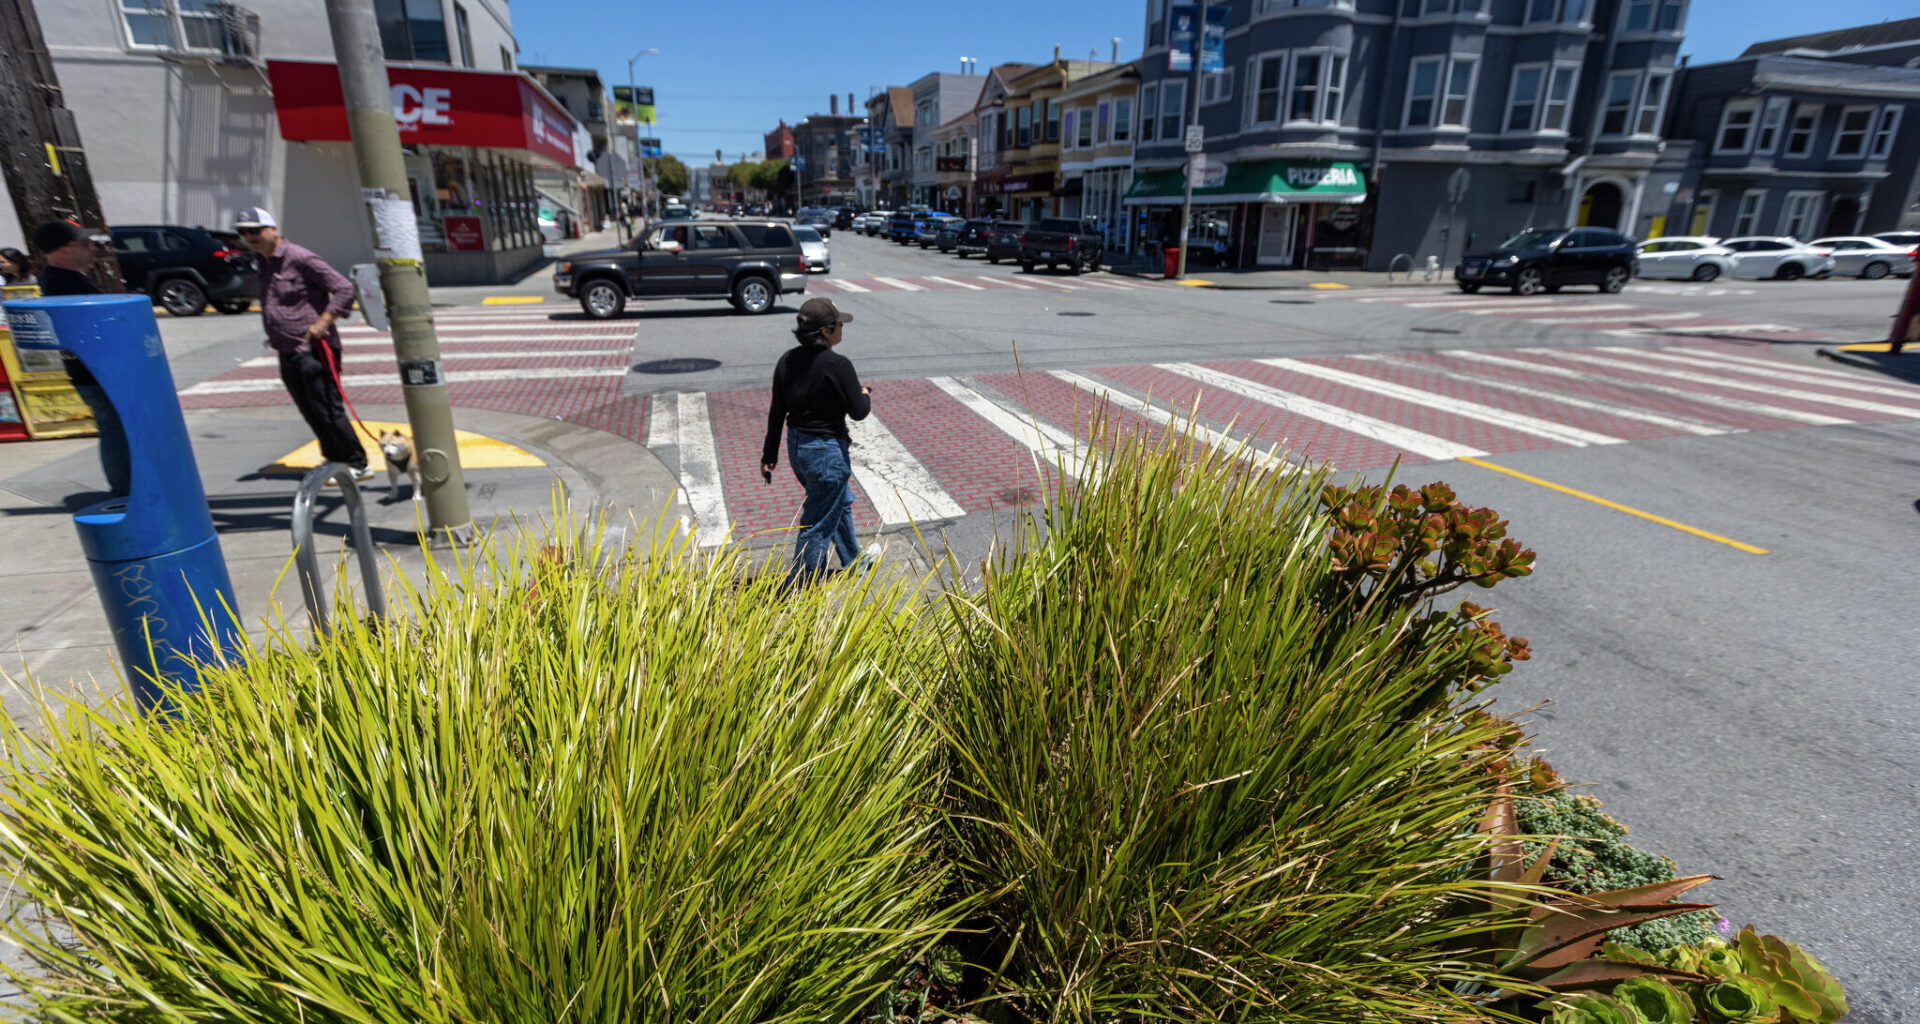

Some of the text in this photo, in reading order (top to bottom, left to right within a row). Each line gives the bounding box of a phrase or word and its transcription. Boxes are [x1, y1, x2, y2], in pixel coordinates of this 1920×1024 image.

[390, 84, 451, 124] CE
[1187, 138, 1201, 148] 20
[1287, 167, 1358, 186] PIZZERIA
